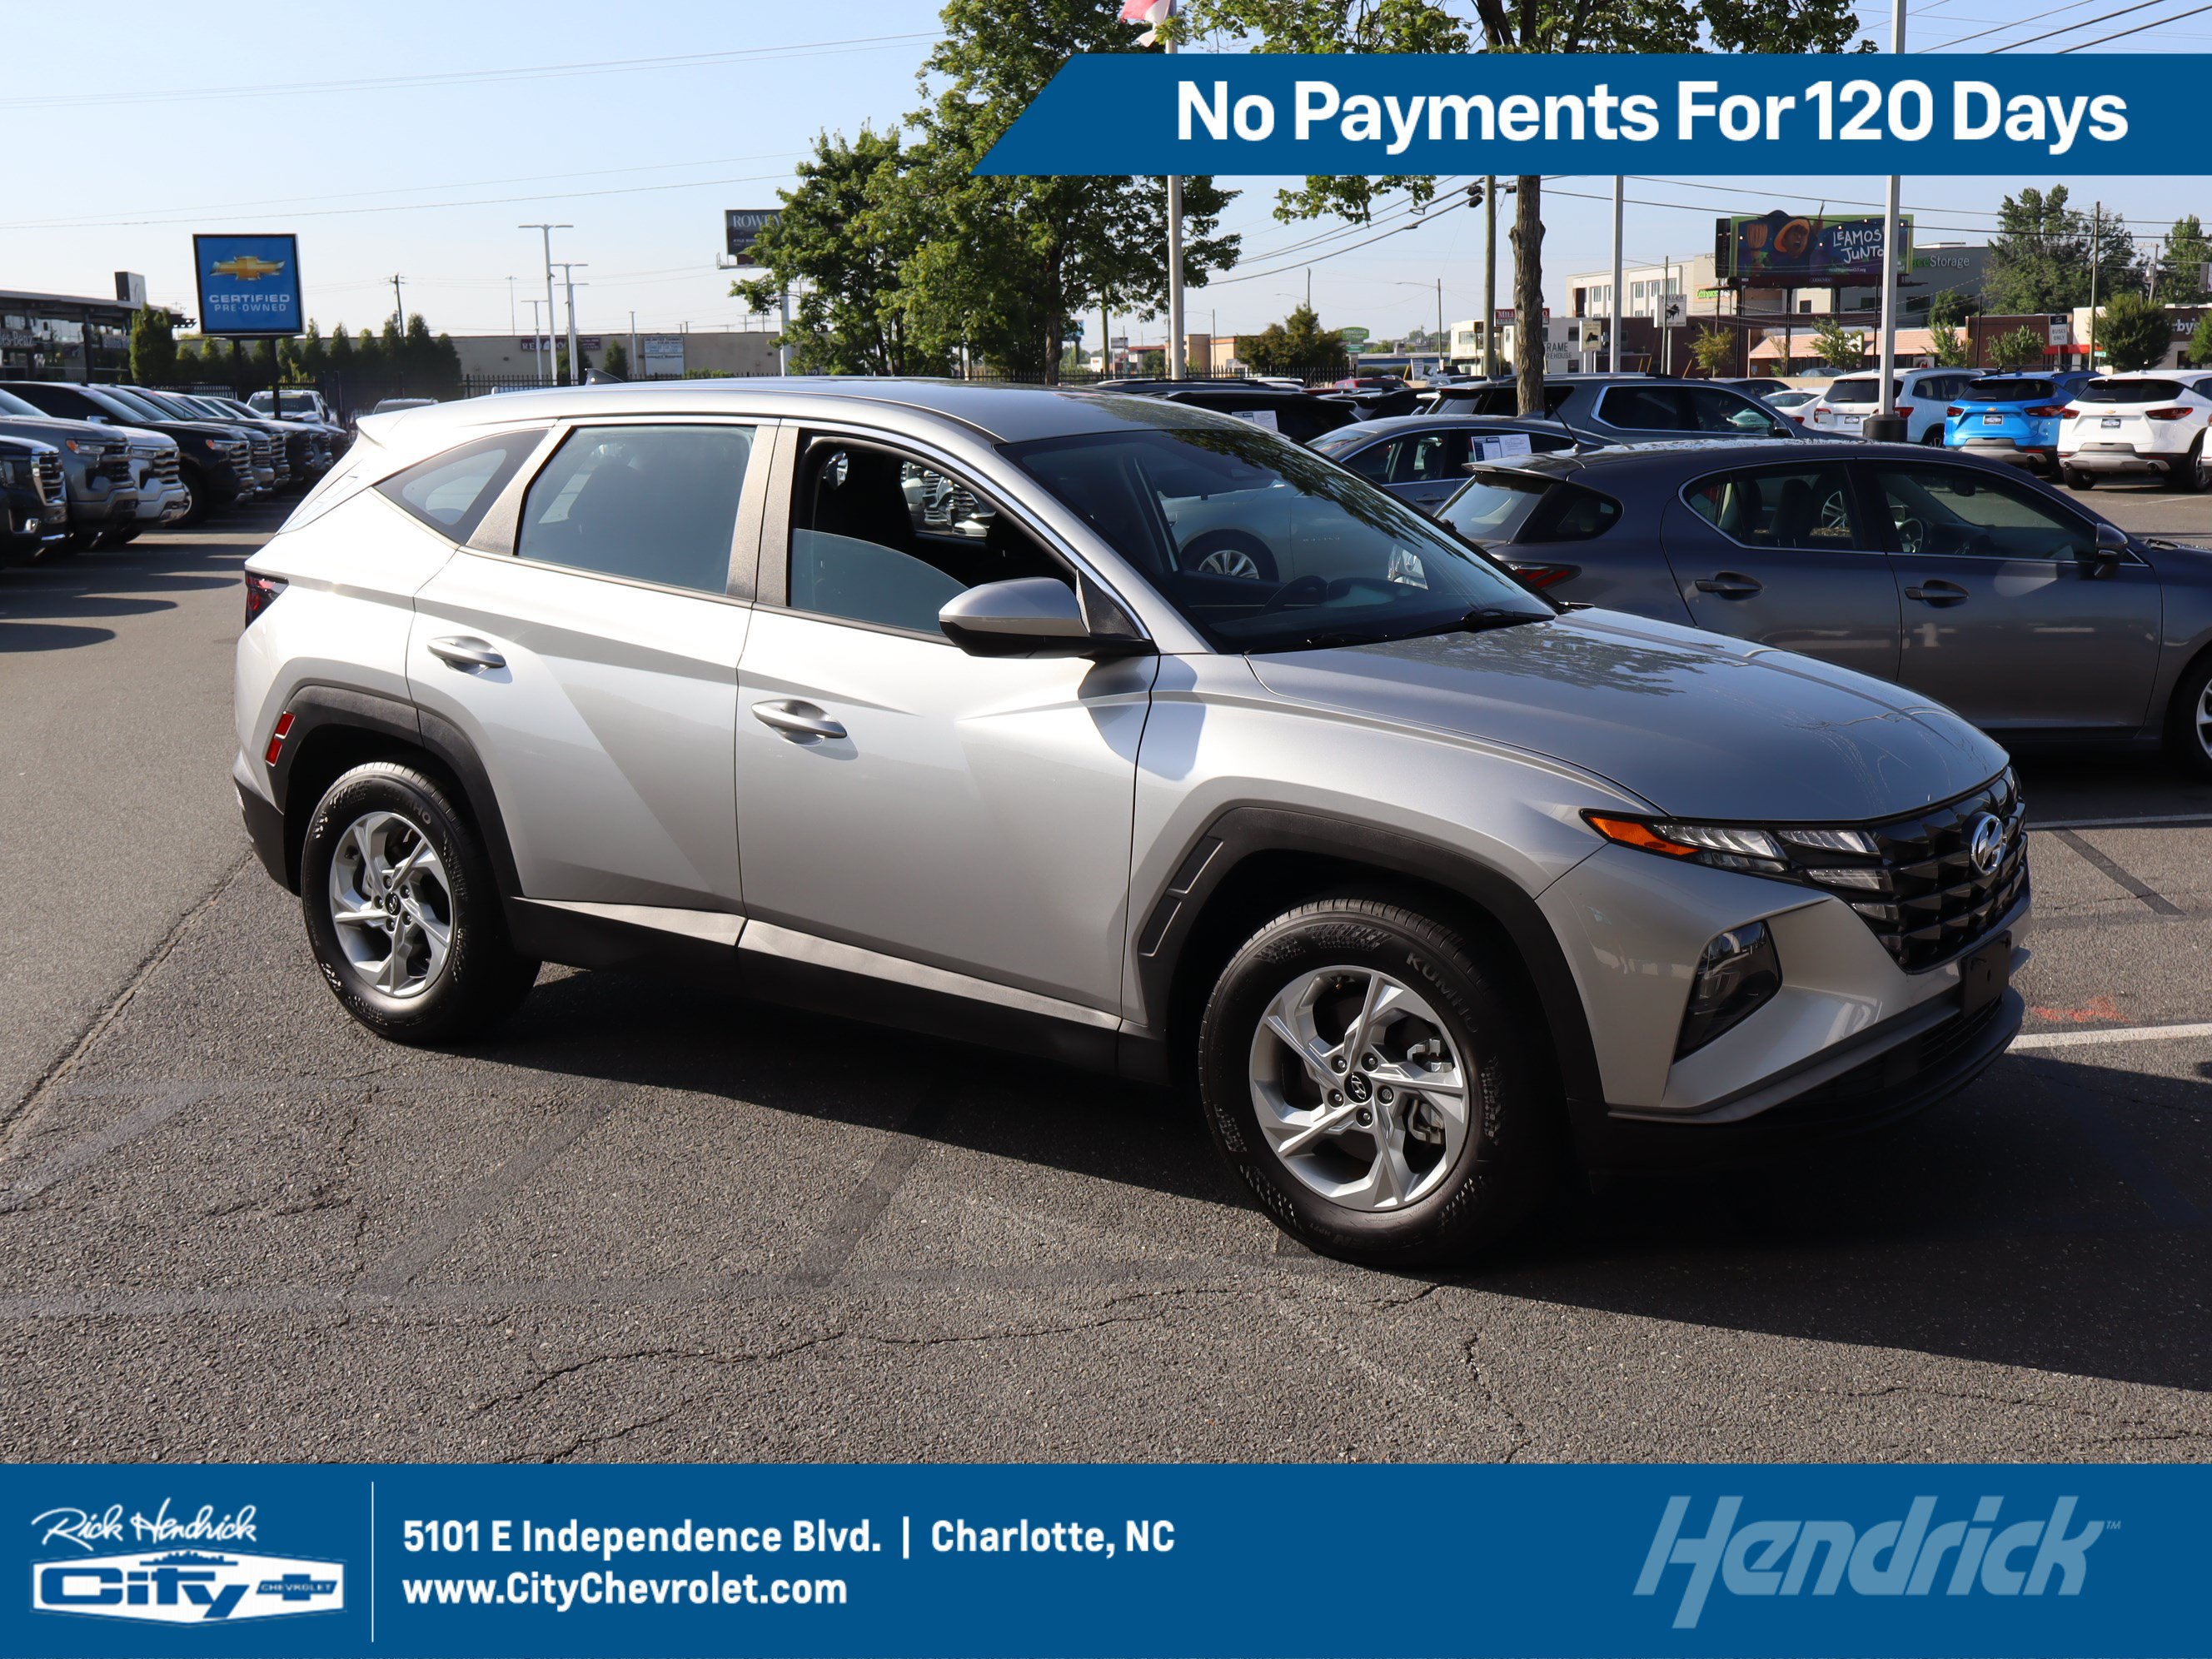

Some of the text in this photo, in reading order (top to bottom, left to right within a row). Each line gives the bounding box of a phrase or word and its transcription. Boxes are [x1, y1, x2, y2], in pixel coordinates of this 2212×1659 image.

[1832, 229, 1882, 247] LEAMOS
[1840, 245, 1885, 265] JUNTO
[209, 294, 291, 303] CERTIFIED
[214, 303, 287, 312] PRE-OWNED
[0, 330, 34, 347] es-Benz
[1545, 341, 1569, 352] RAME
[1546, 351, 1573, 360] REHOUSE
[1406, 952, 1479, 1034] KUMHO
